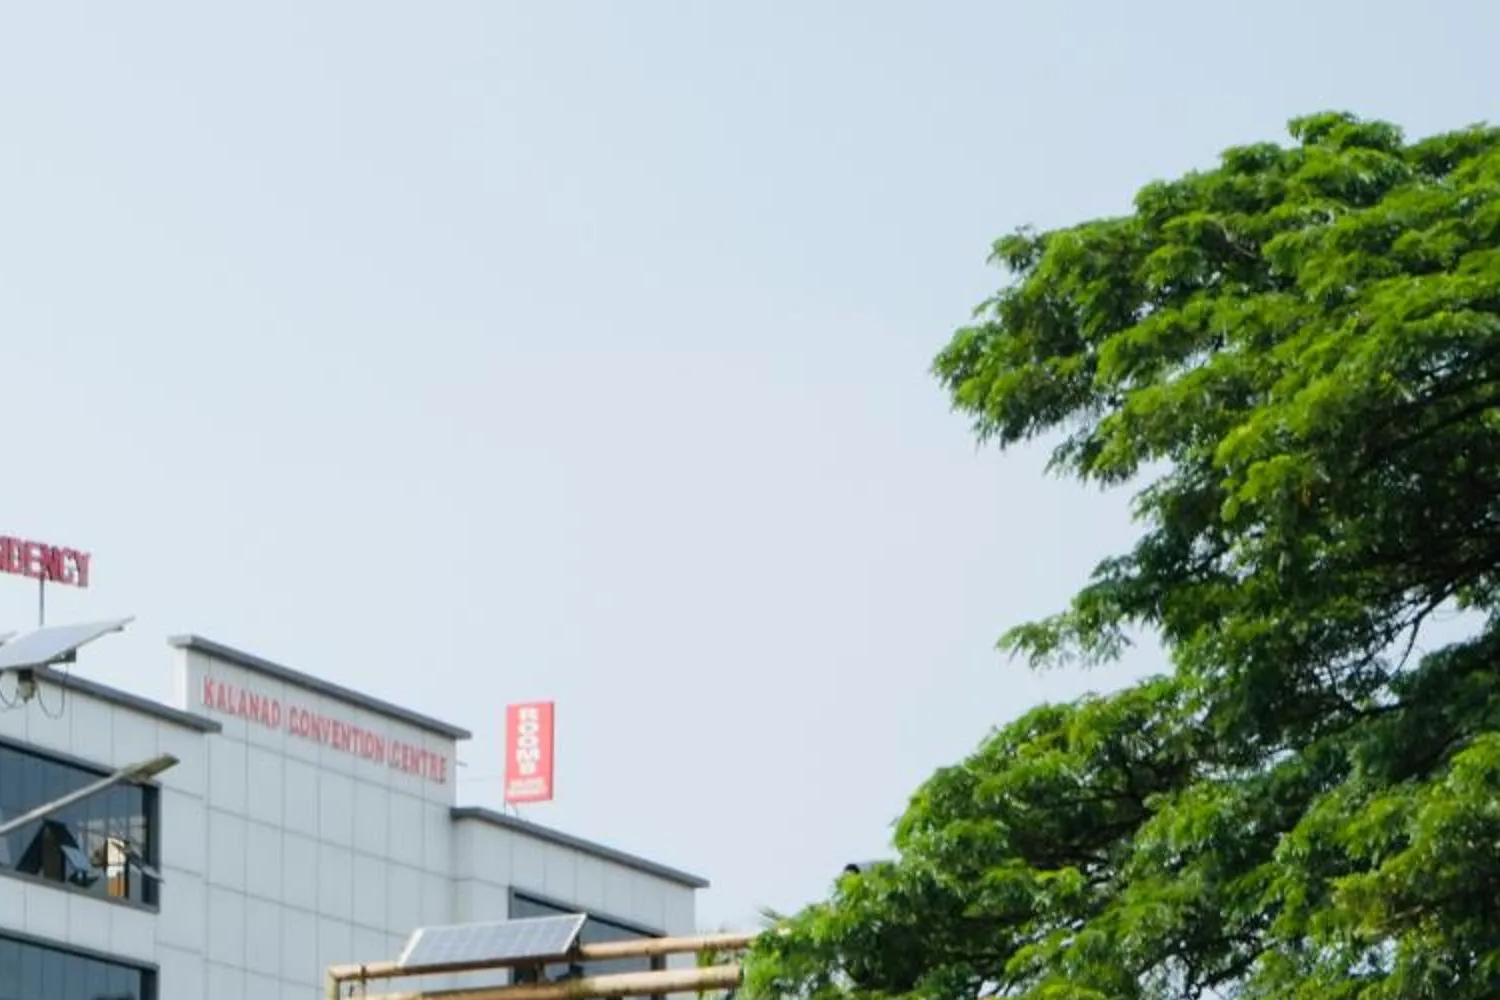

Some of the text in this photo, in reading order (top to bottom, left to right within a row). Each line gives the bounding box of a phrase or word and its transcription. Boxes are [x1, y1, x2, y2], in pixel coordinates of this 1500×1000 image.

[204, 676, 448, 784] KALANAD CONVENTION CENTRE
